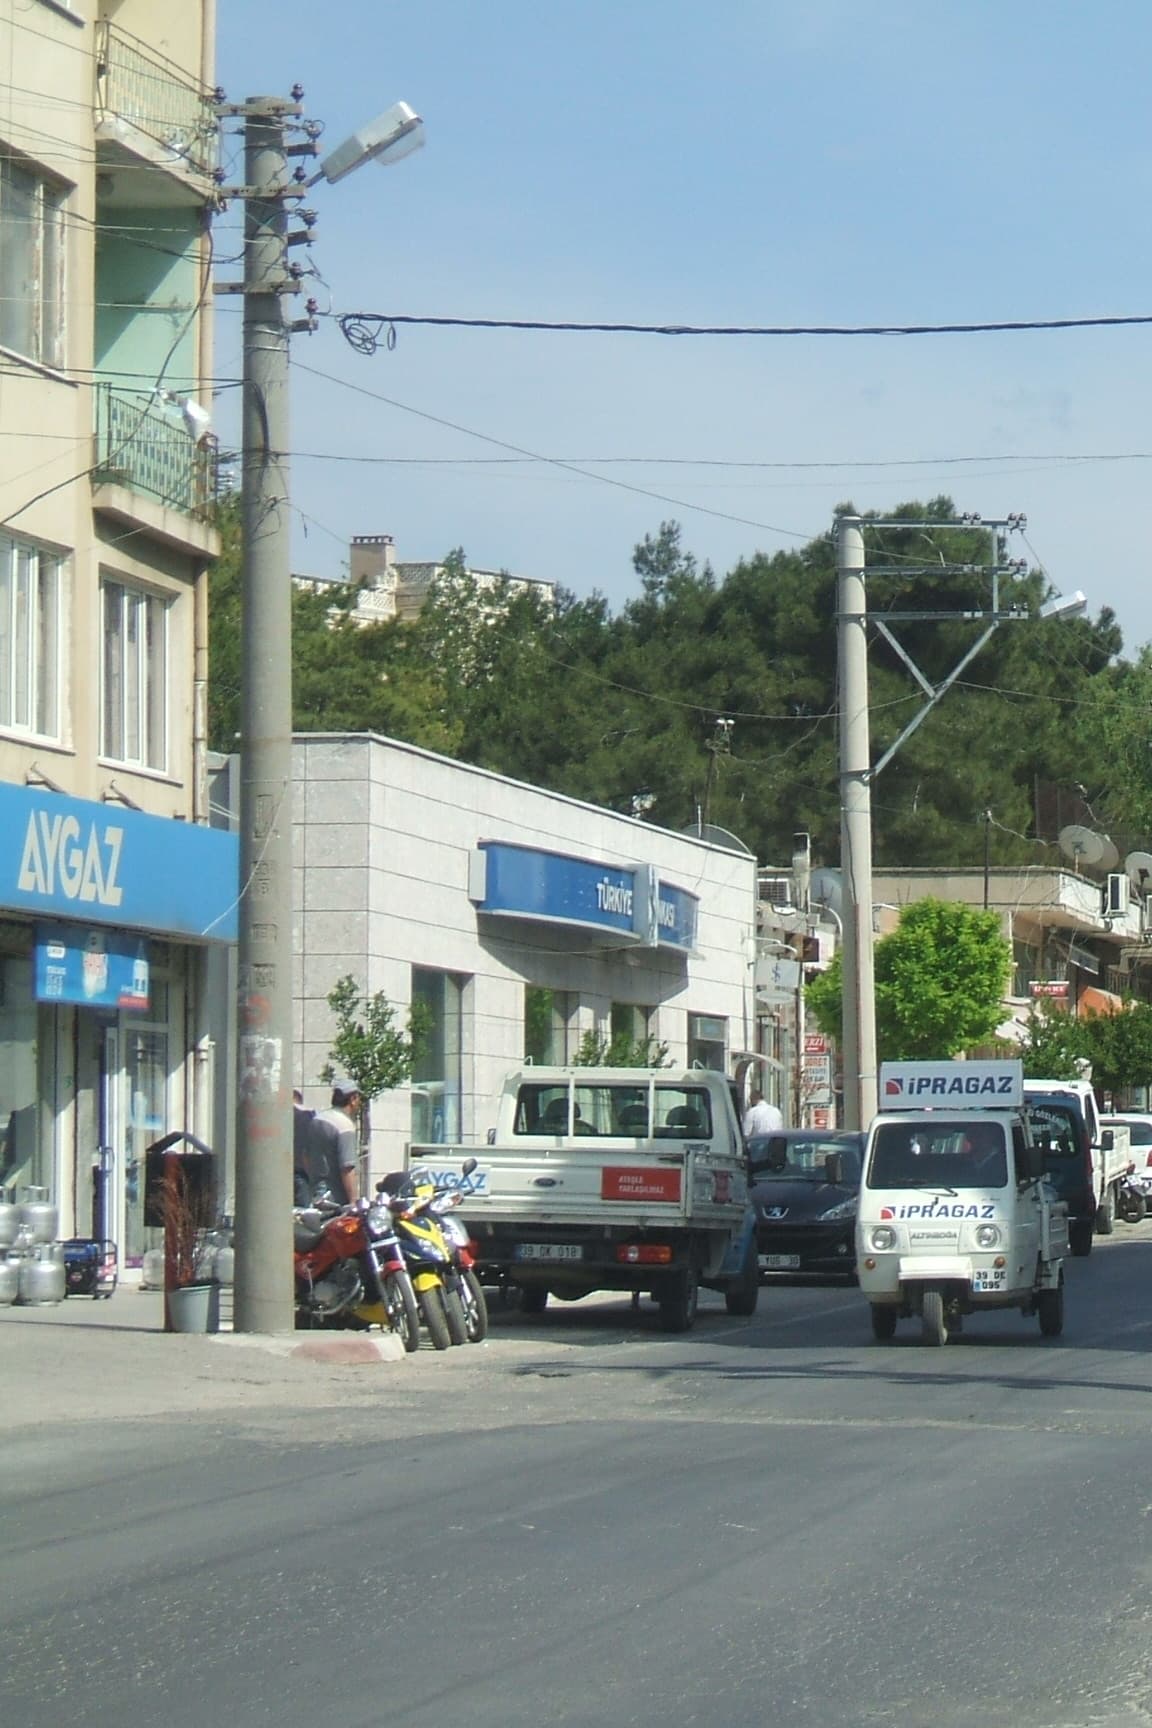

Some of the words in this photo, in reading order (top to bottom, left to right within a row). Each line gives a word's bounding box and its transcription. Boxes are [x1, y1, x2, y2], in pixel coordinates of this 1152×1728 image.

[18, 807, 124, 907] AYGAZ
[597, 876, 633, 916] TÜRKİYE
[975, 1271, 988, 1280] 39
